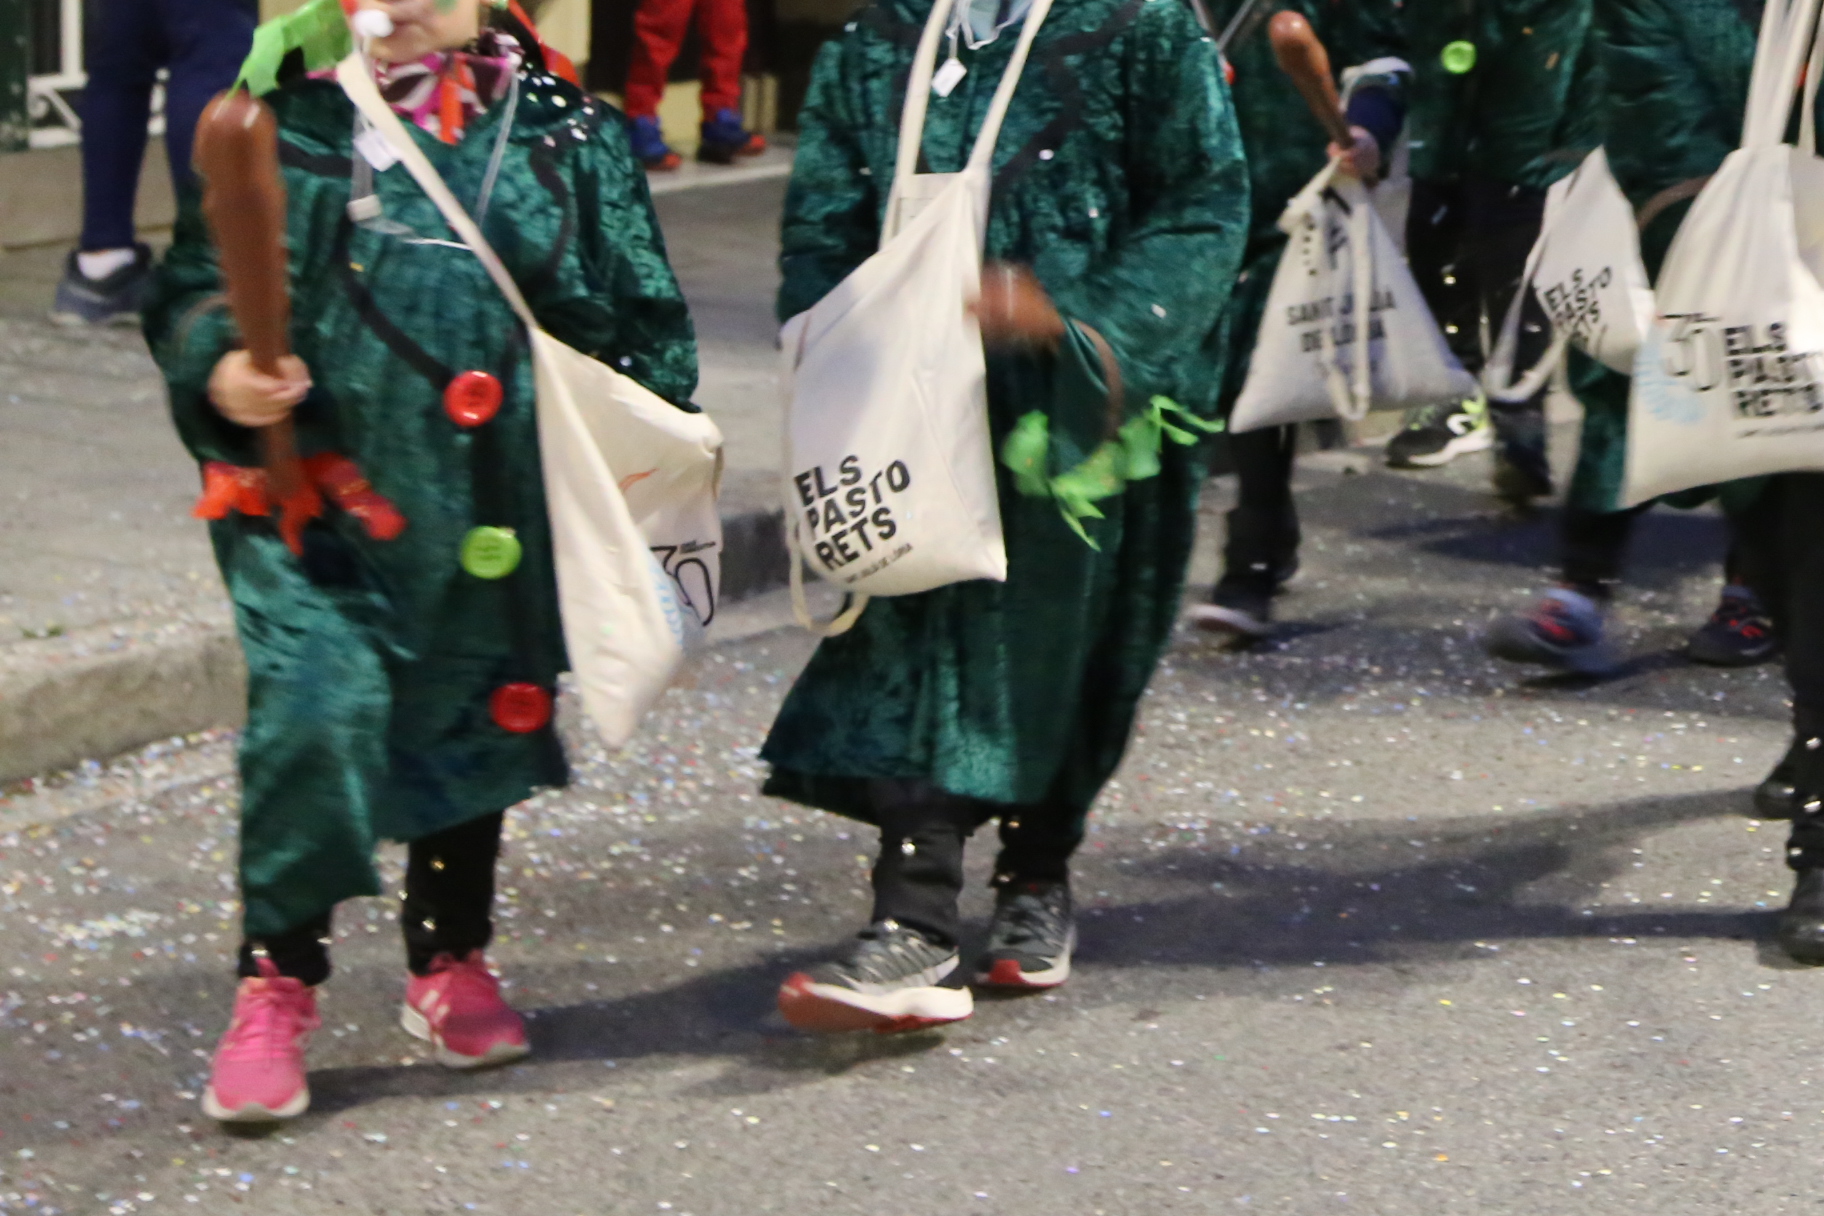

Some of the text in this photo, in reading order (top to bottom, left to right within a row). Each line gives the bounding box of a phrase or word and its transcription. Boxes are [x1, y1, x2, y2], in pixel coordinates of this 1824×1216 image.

[1543, 268, 1583, 312] ELS
[1302, 329, 1321, 353] DE
[1724, 322, 1788, 356] ELS
[793, 454, 863, 508] ELS
[803, 459, 911, 541] PASTO
[813, 507, 897, 572] RETS
